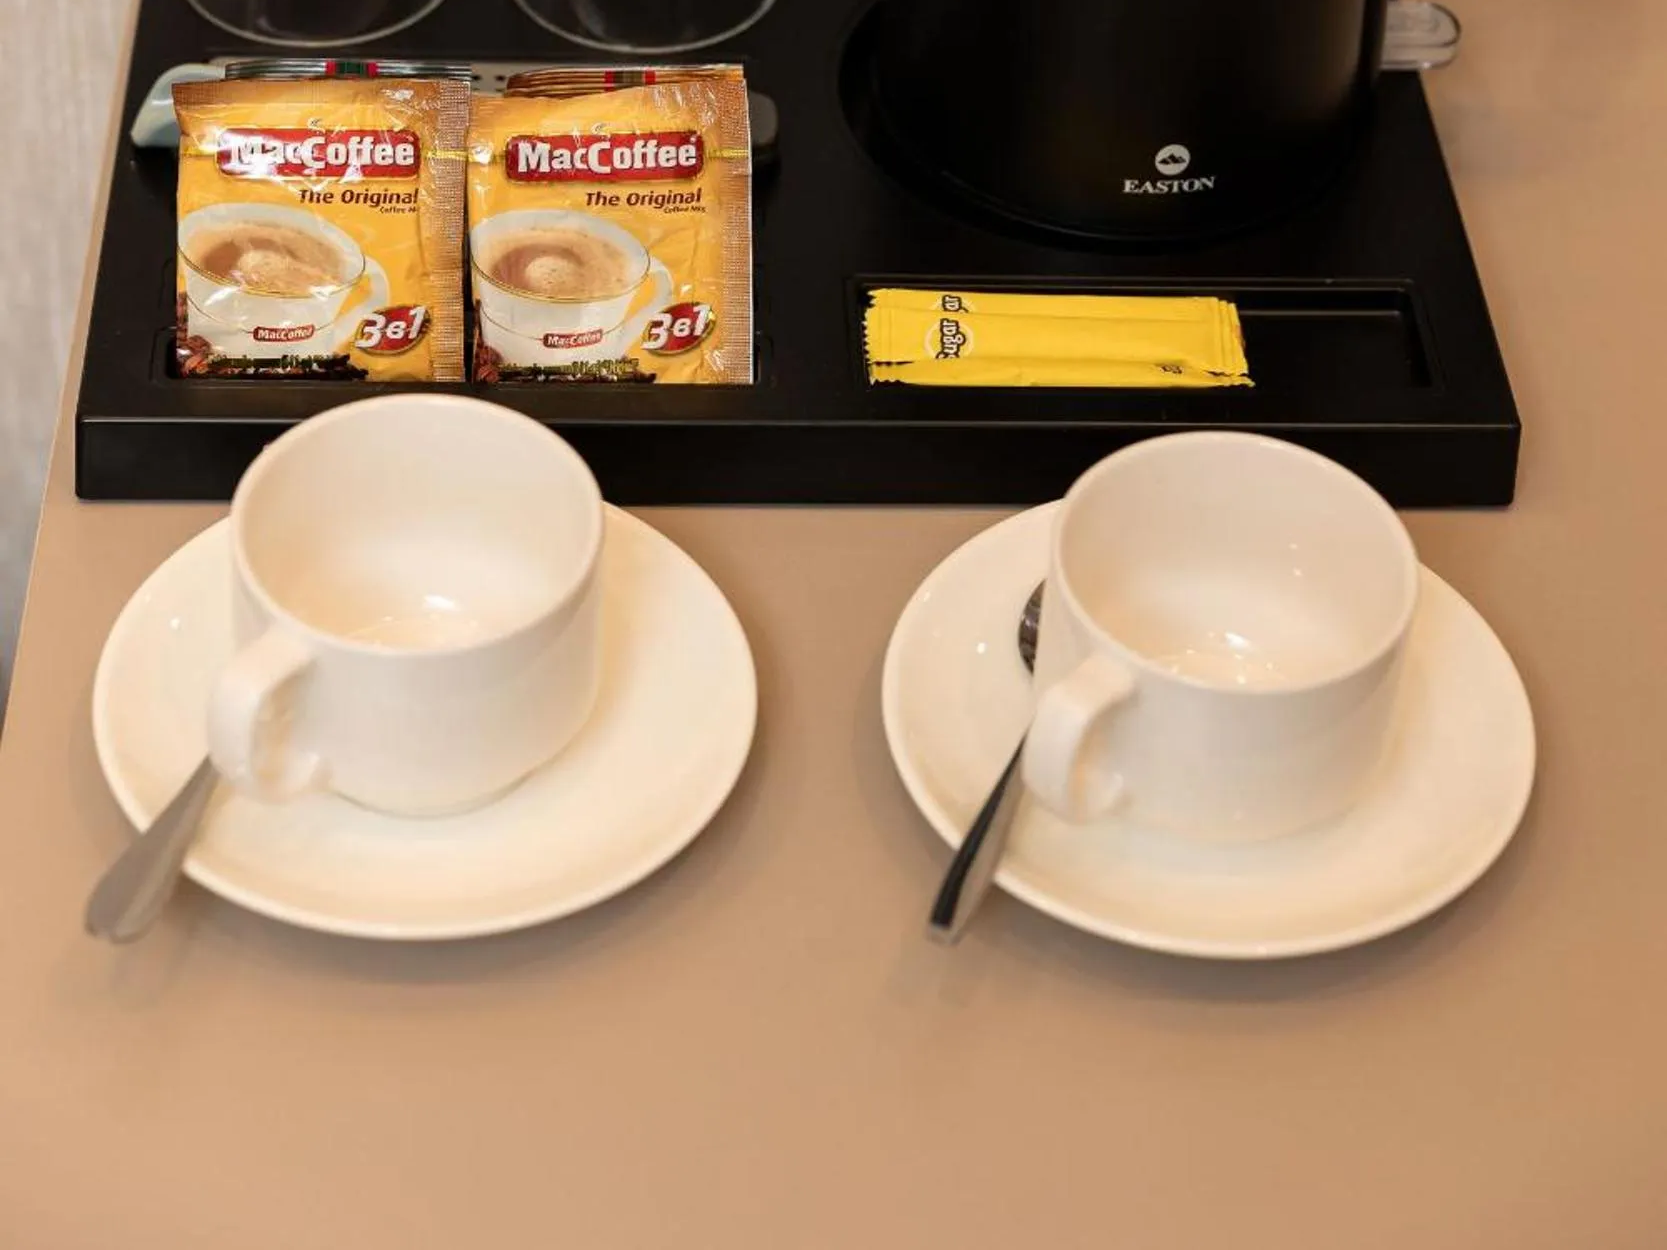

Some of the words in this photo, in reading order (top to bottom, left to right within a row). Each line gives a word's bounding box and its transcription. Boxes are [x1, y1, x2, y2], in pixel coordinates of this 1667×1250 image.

[229, 136, 415, 170] MacCoffee
[517, 139, 698, 174] MacCoffee
[1123, 176, 1215, 194] EASTON
[299, 188, 334, 204] The
[341, 187, 419, 208] Original
[585, 191, 620, 206] The
[626, 187, 701, 209] Original
